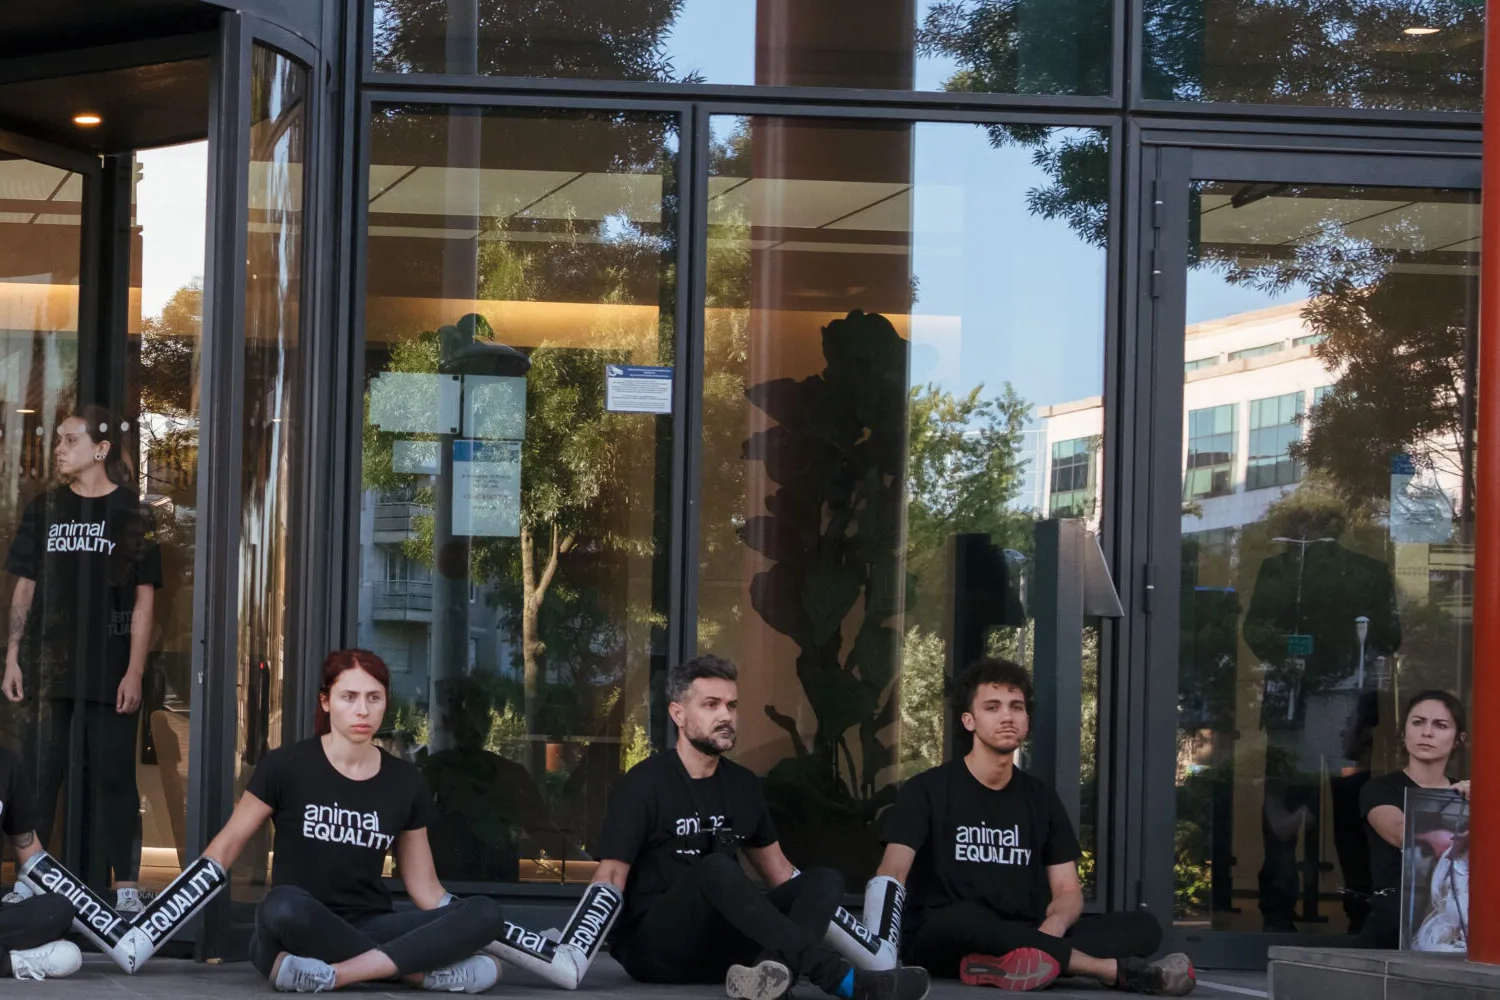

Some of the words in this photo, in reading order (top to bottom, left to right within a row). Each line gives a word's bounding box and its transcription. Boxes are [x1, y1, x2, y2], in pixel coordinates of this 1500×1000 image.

[48, 519, 106, 538] animal
[46, 536, 116, 556] EQUALITY
[303, 801, 379, 832] animal
[302, 820, 394, 850] EQUALITY
[955, 820, 1019, 848] animal
[955, 843, 1032, 866] EQUALITY
[41, 867, 123, 936] animal
[140, 861, 220, 942] EQUALITY
[569, 887, 617, 955] EQUALITY
[835, 905, 873, 944] mal
[503, 920, 548, 954] mal
